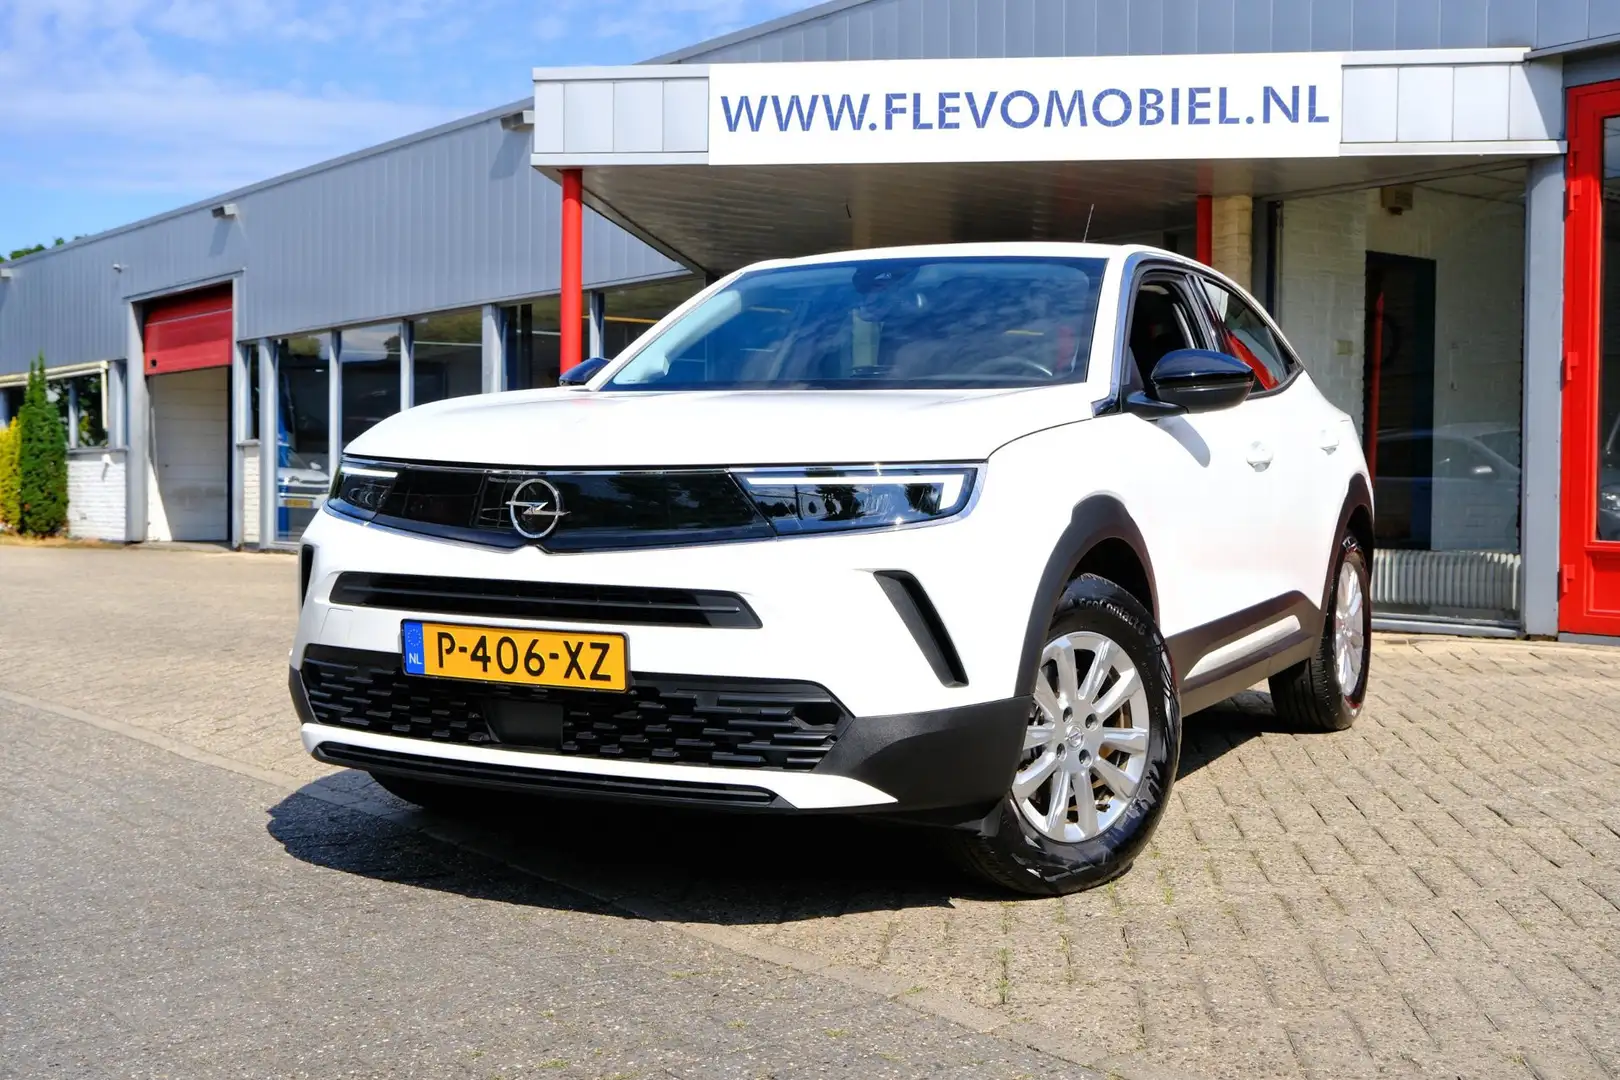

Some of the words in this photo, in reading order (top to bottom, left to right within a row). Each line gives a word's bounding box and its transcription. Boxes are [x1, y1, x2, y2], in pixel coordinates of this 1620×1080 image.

[721, 85, 1329, 132] WWW.FLEVOMOBIEL.NL
[409, 653, 422, 665] NL
[437, 631, 612, 682] P-406-XZ
